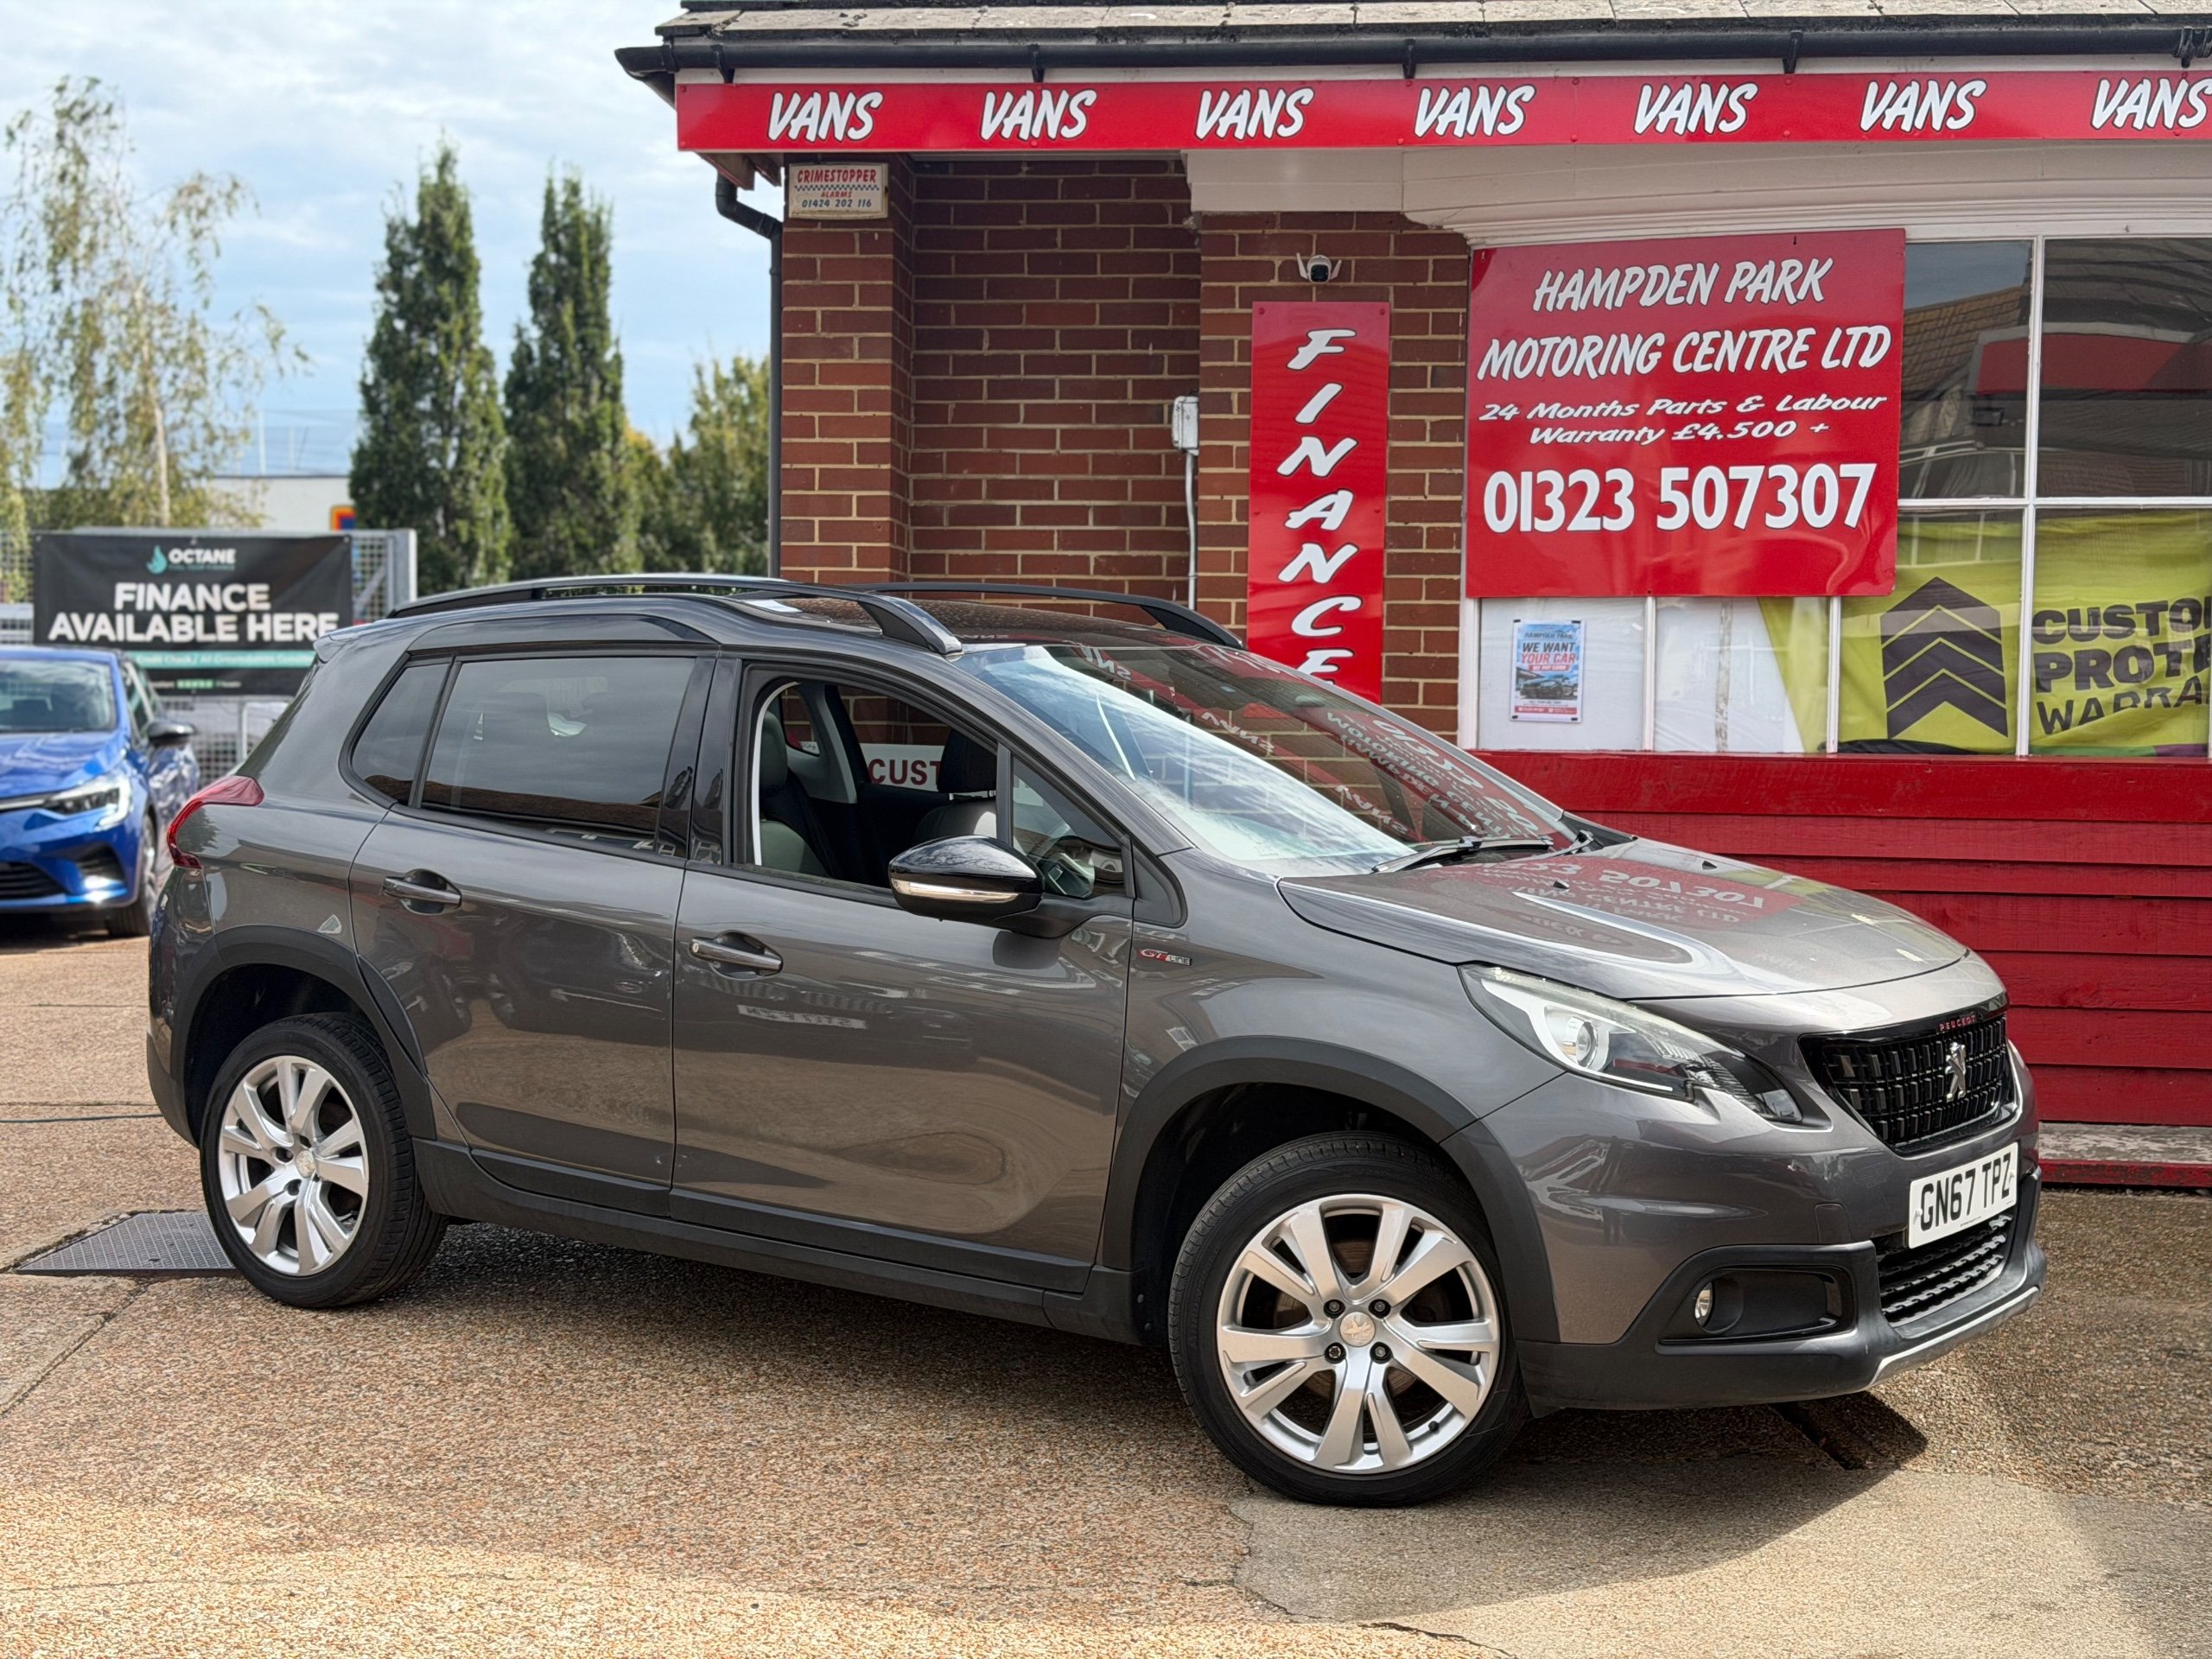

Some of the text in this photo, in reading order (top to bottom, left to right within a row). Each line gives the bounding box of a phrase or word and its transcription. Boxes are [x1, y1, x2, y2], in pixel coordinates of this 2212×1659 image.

[767, 92, 884, 142] VANS
[980, 89, 1097, 141] VANS
[1195, 87, 1314, 140] VANS
[1414, 85, 1536, 138] VANS
[1633, 83, 1759, 136] VANS
[1859, 79, 1988, 132] VANS
[2091, 78, 2212, 130] VANS
[798, 168, 877, 183] CRIMESTOPPER
[802, 199, 872, 208] 01424 202 116
[1532, 257, 1834, 313] HAMPDEN PARK
[1477, 325, 1891, 381] MOTORING CENTRE LTD
[1478, 392, 1888, 421] 24 Months Parts & Labour
[1529, 426, 1666, 446] Warranty
[1809, 423, 1829, 434] +
[1277, 328, 1363, 685] FINANCE
[1484, 462, 1877, 533] 01323 507307
[168, 548, 237, 564] OCTANE
[114, 582, 272, 612] FINANCE
[2032, 596, 2210, 645] CUSTO
[48, 612, 340, 643] AVAILABLE HERE
[1522, 642, 1576, 652] WE WANT
[1521, 653, 1577, 664] YOUR CAR
[1939, 1014, 1976, 1032] PEUGEOT
[1920, 1151, 2012, 1232] GN67 TPZ
